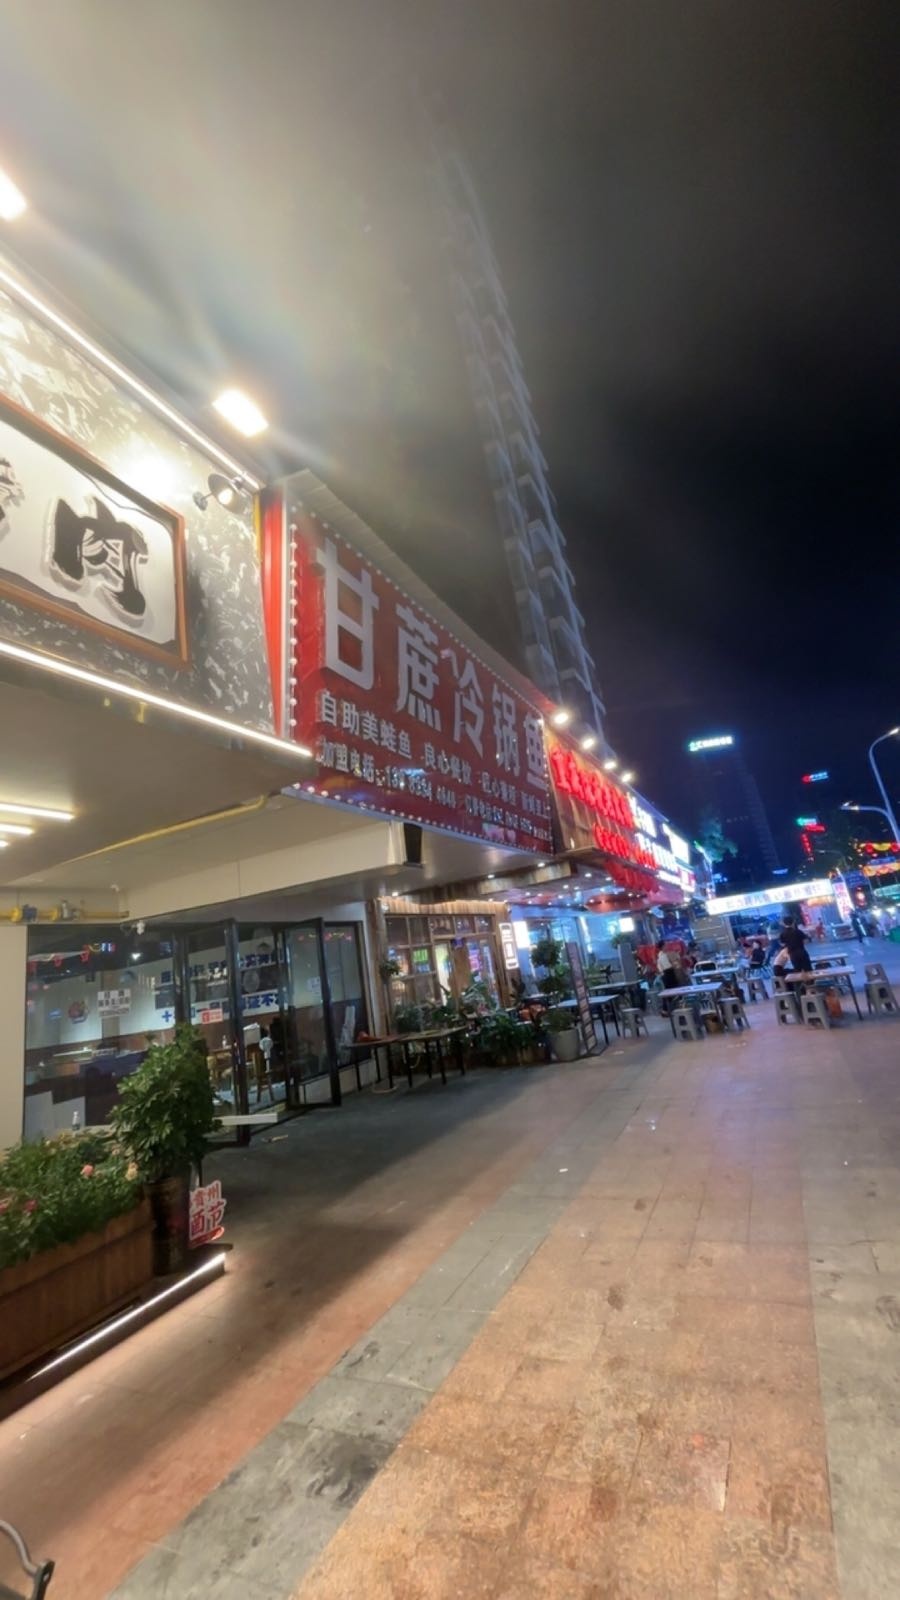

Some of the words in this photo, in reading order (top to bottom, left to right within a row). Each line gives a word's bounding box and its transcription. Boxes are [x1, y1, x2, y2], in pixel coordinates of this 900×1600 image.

[315, 537, 549, 790] 甘蔗冷锅鱼
[320, 690, 412, 760] 自助美蛙鱼
